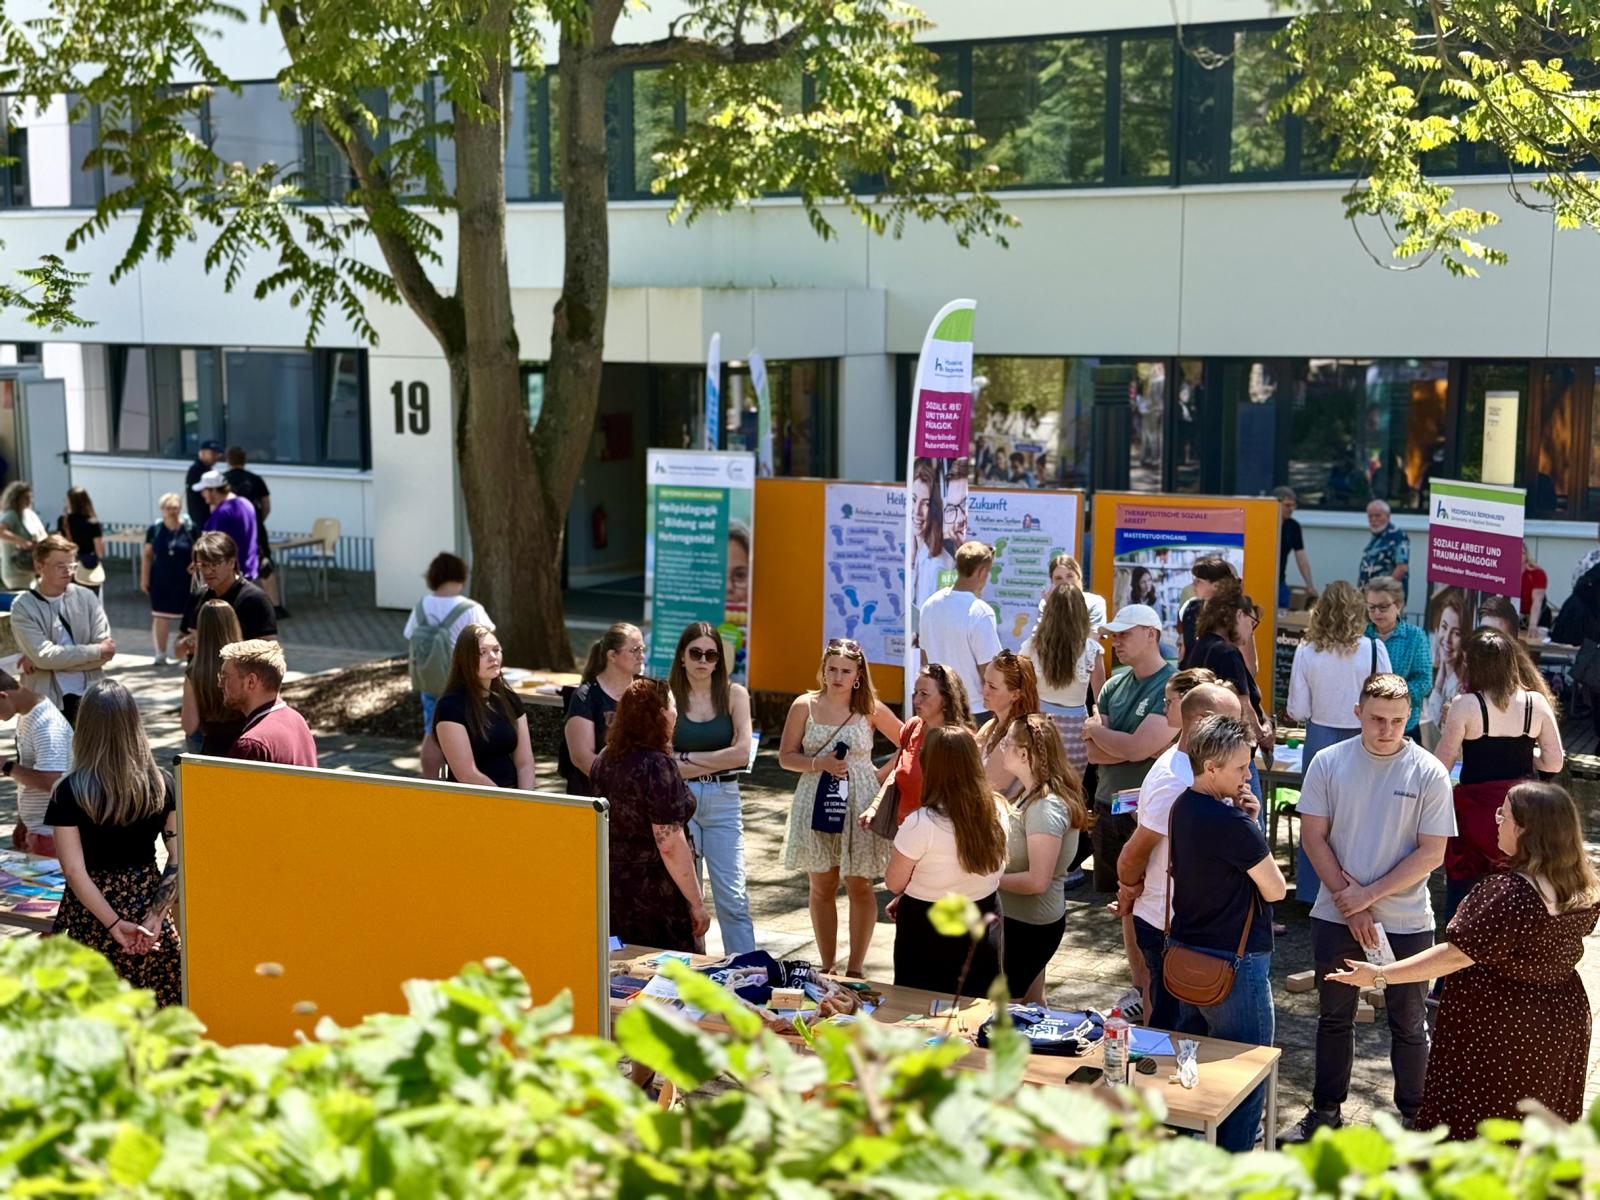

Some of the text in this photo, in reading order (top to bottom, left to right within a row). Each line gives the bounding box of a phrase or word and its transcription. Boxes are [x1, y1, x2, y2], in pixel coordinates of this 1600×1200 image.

[390, 380, 431, 436] 19
[658, 503, 718, 517] Heilpädagogik
[969, 497, 1008, 511] Zukunft
[1124, 510, 1179, 519] THERAPEUTISCHE
[664, 518, 697, 531] Bildung
[698, 519, 716, 530] und
[658, 532, 715, 545] Heterogenität
[1123, 533, 1187, 541] MASTERSTUDIENGANG
[1433, 538, 1502, 557] SOZIALE ARBEIT UND
[1433, 549, 1498, 569] TRAUMAPÄDAGOGIK
